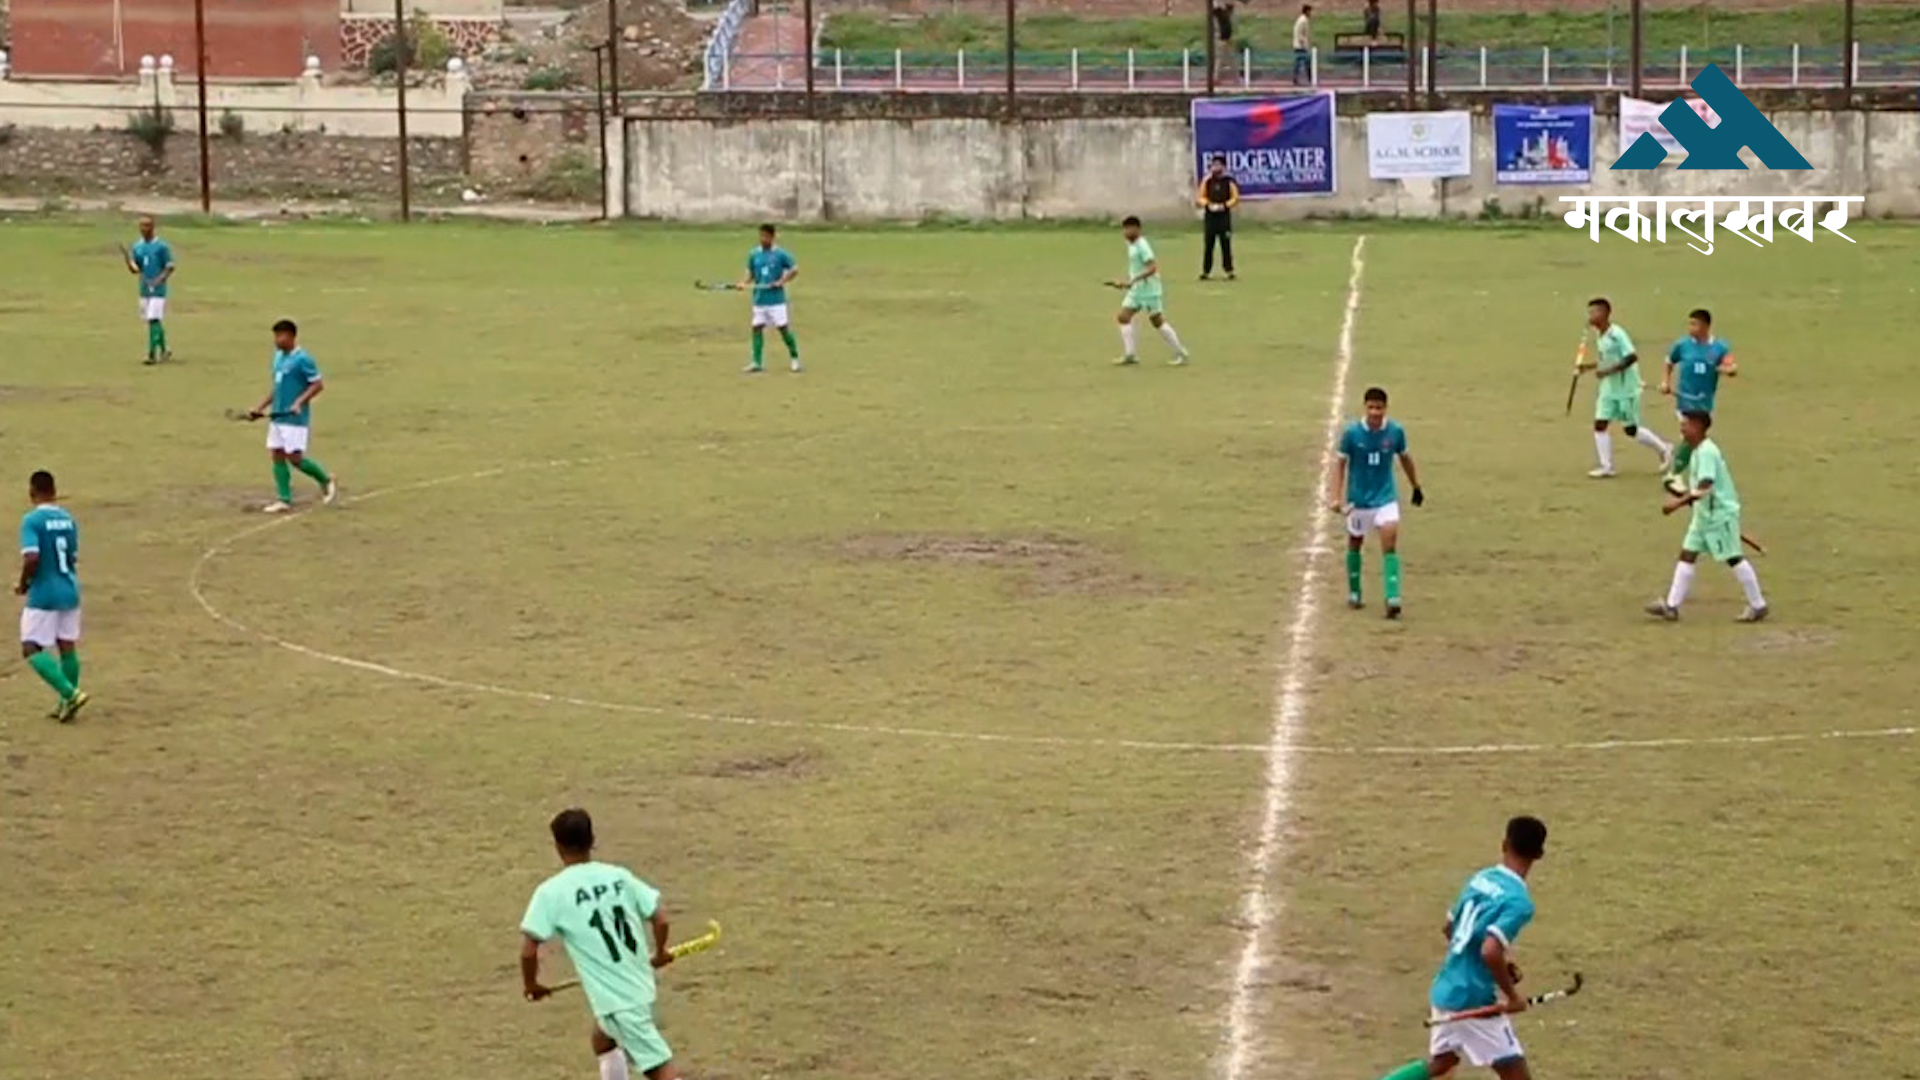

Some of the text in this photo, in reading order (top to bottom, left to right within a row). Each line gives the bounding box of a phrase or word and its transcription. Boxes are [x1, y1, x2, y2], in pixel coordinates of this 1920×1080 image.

[1202, 147, 1325, 172] BIDGEWATER
[1414, 145, 1461, 157] SCHOOL
[576, 880, 624, 905] APF
[589, 906, 638, 962] 14
